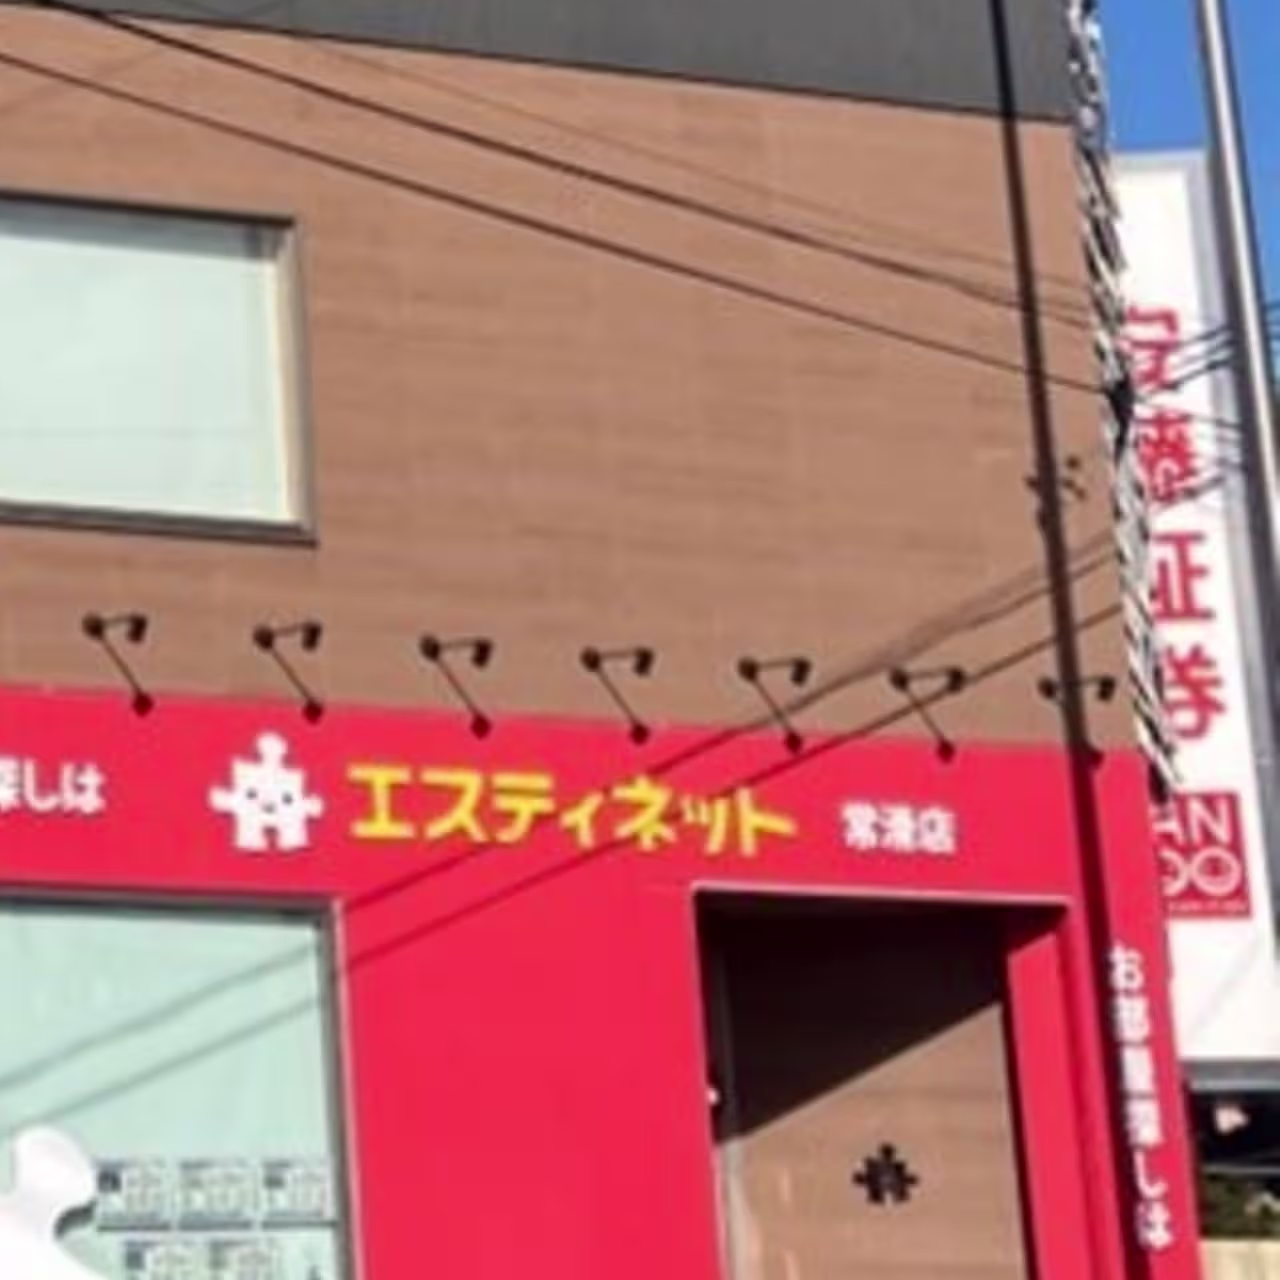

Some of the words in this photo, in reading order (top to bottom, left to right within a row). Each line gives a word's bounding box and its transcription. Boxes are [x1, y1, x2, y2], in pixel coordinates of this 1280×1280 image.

[347, 763, 798, 857] エスティネット
